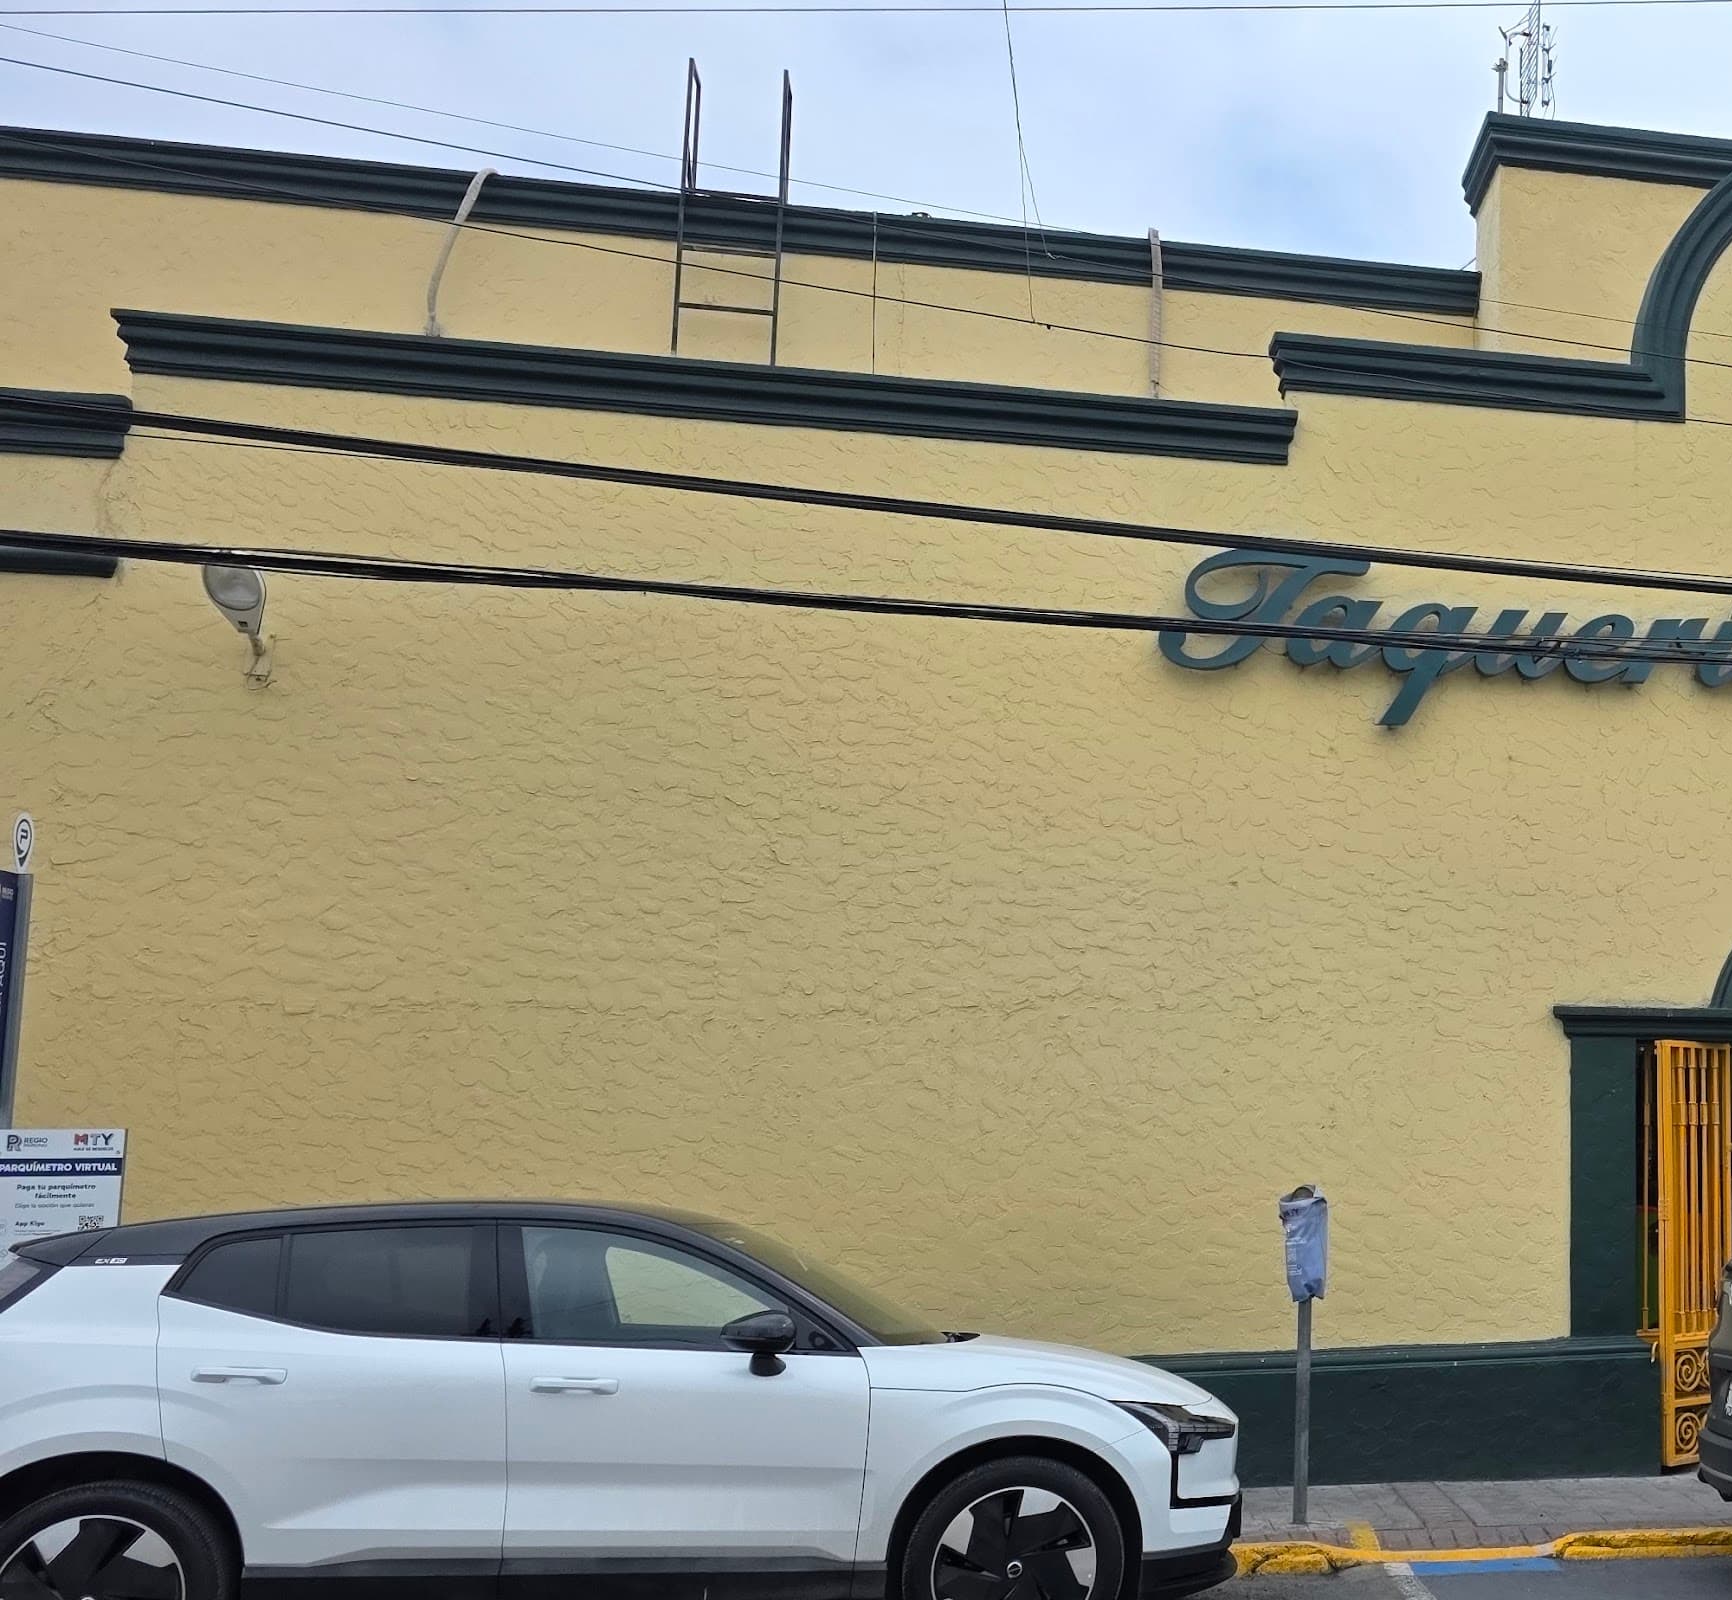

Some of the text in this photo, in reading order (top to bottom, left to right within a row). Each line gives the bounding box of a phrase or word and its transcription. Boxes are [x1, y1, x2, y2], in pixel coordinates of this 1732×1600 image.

[73, 1133, 114, 1146] MTY
[0, 1161, 118, 1172] PARQUÍMETRO VIRTUAL
[16, 1184, 35, 1192] Paga
